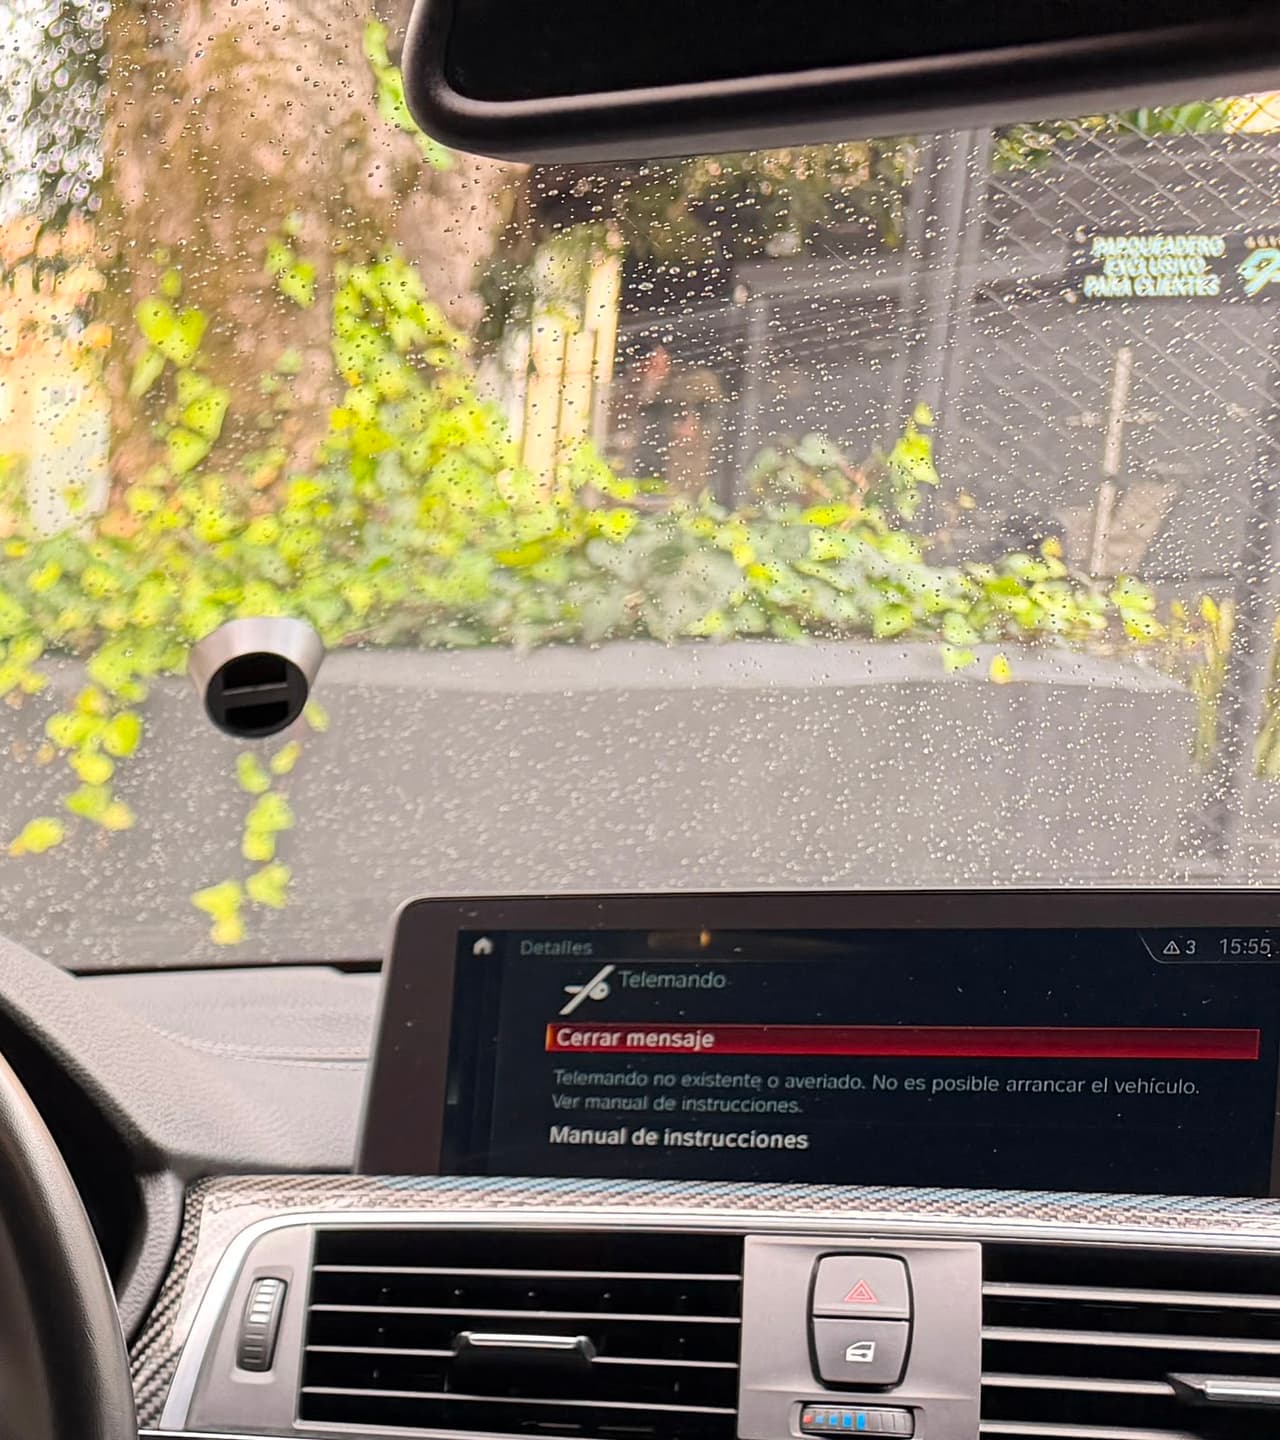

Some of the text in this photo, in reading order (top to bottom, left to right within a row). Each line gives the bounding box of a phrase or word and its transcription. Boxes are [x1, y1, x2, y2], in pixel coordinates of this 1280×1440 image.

[520, 940, 593, 955] Detalles
[1185, 938, 1271, 954] 3 15:55
[618, 970, 726, 988] Telemando
[556, 1027, 714, 1051] Cerrar mensaje
[553, 1068, 1200, 1095] Telemando no existente o averiado. No es posible arrancar el vehículo.
[551, 1094, 803, 1114] Ver manual de instrucciones.
[549, 1126, 809, 1149] Manual de instrucciones
